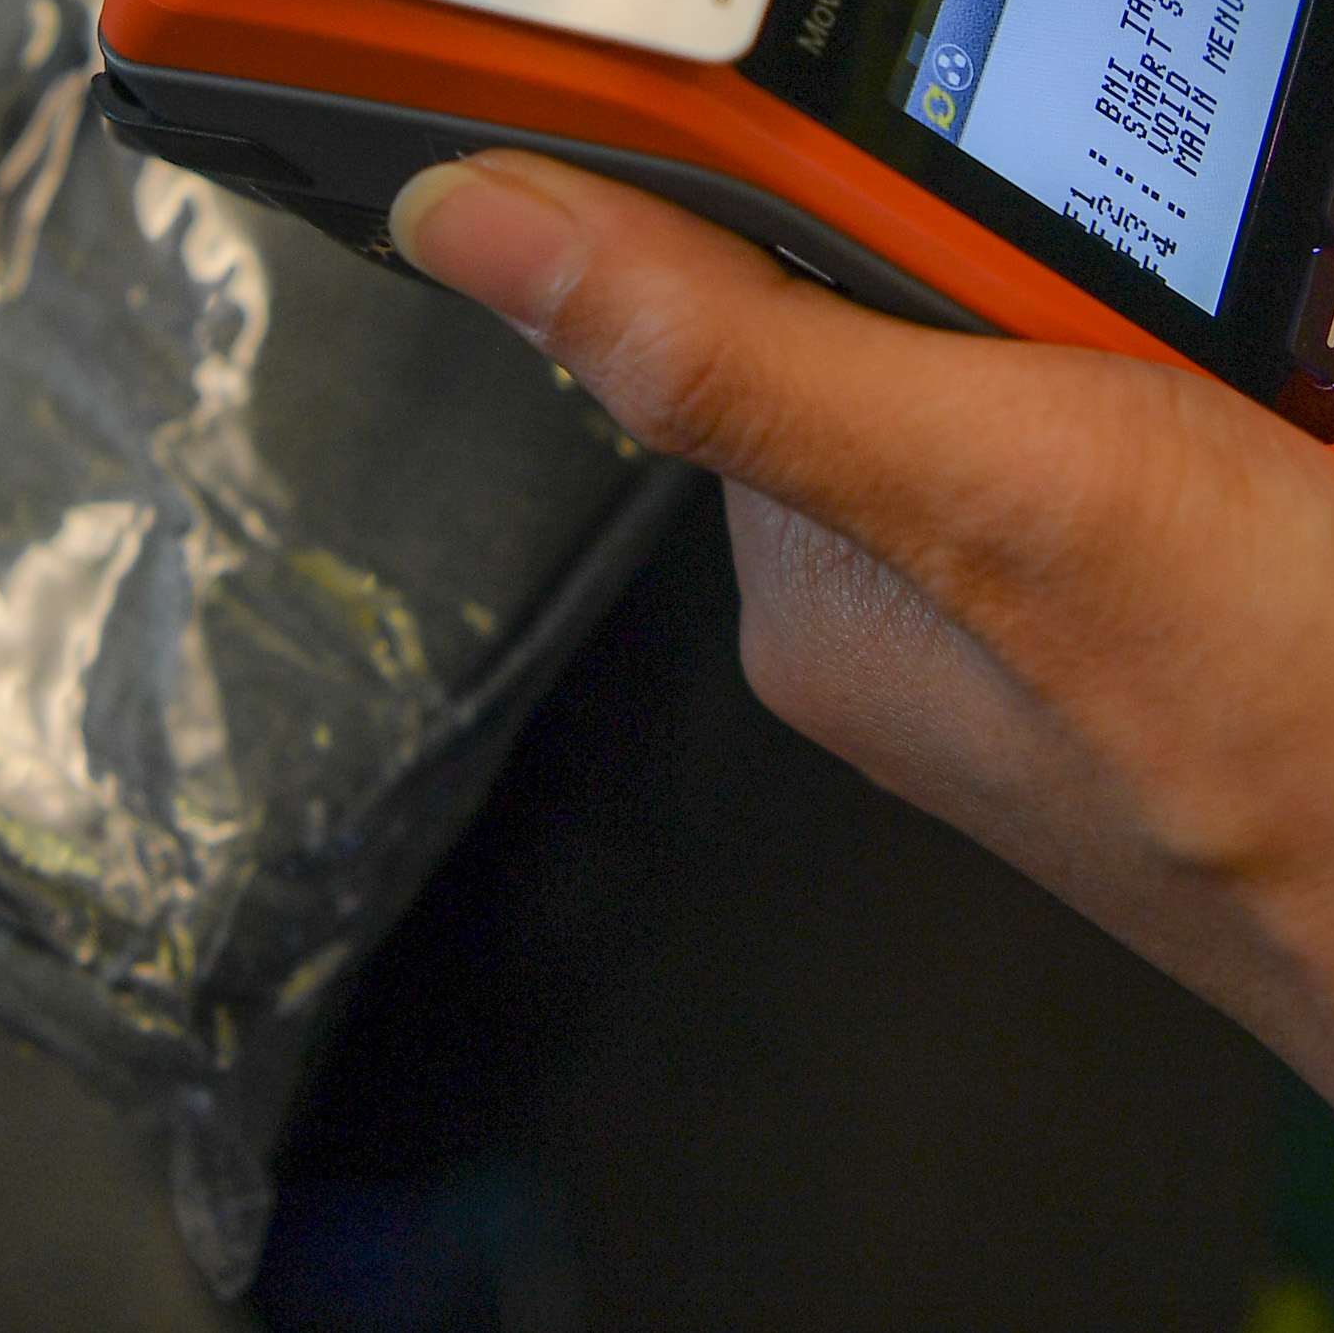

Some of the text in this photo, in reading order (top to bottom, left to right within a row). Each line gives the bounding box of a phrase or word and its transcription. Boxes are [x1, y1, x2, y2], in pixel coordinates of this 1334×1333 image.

[1063, 187, 1096, 221] F1
[1095, 56, 1134, 123] BNI
[1091, 194, 1125, 235] F2
[1121, 27, 1172, 139] SMART
[1117, 212, 1150, 254] F3
[1147, 70, 1191, 155] VOID
[1142, 232, 1177, 272] F4
[1171, 85, 1218, 177] MAIN
